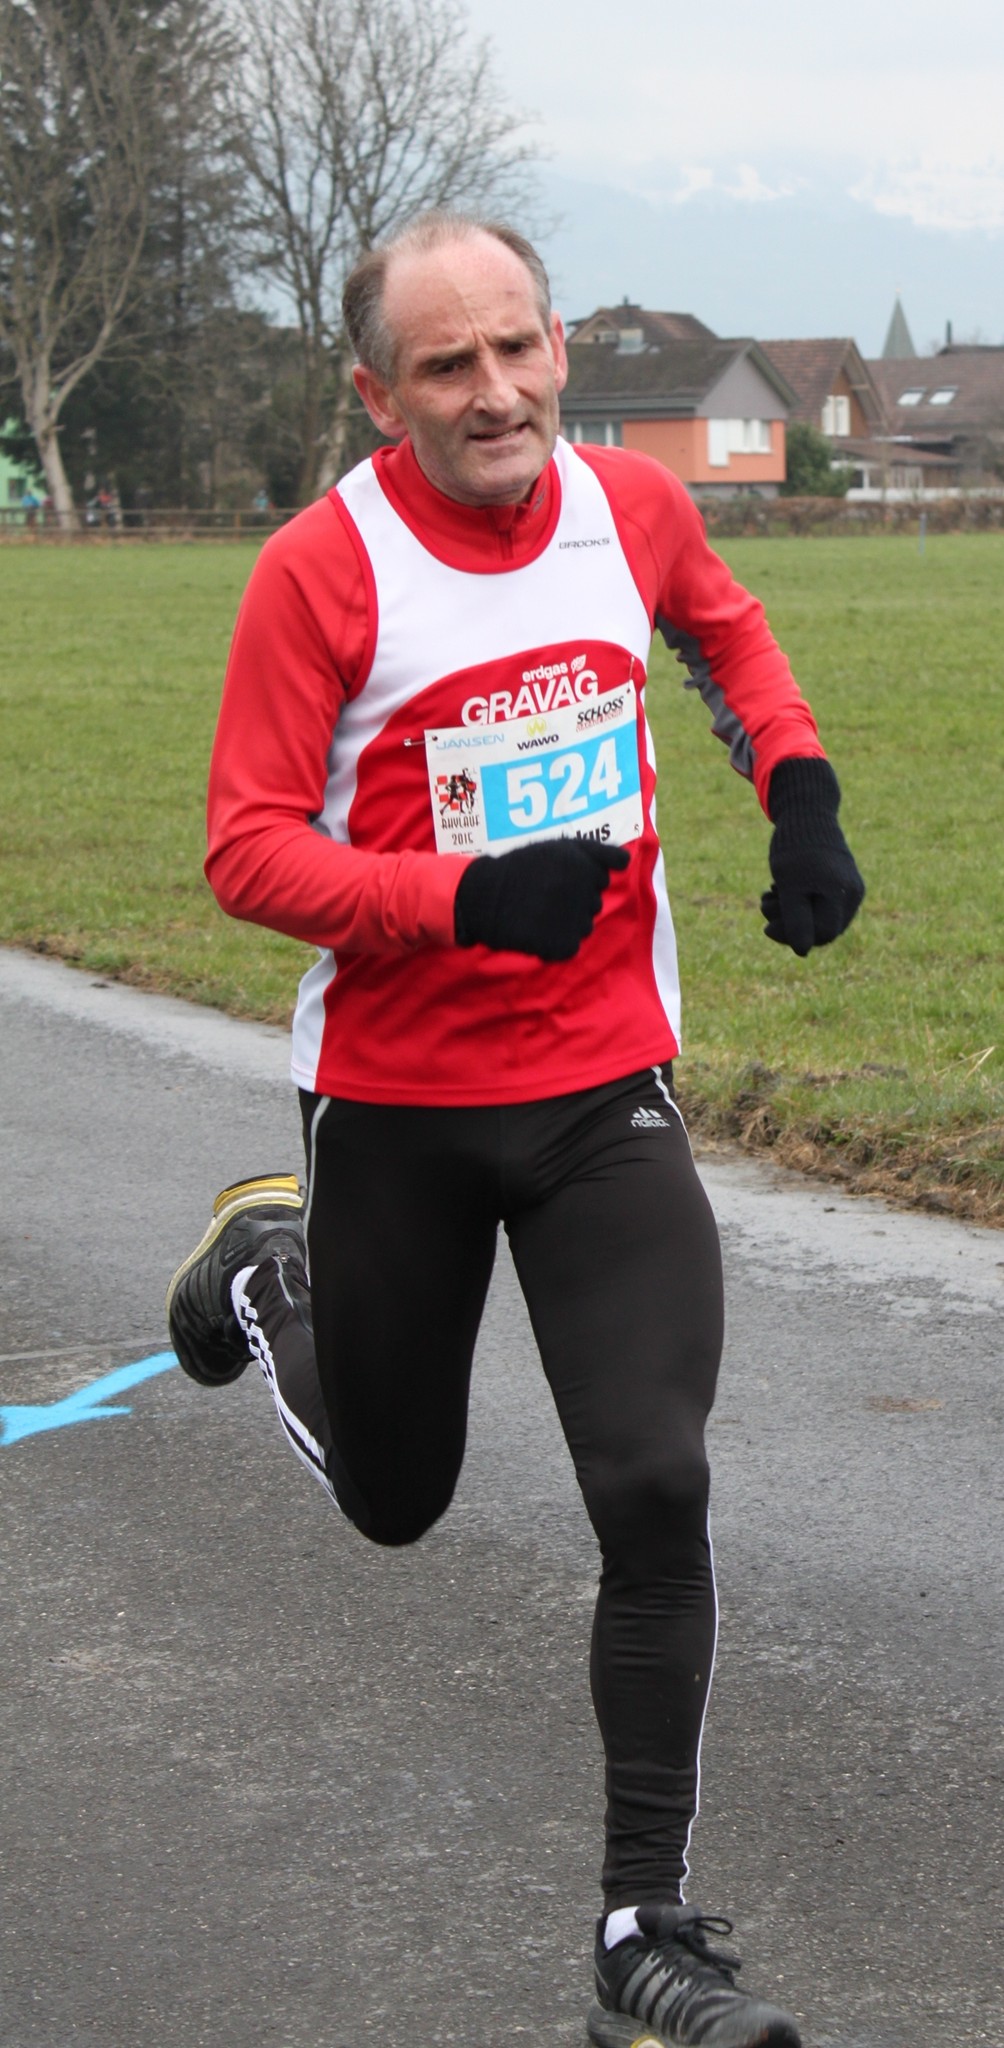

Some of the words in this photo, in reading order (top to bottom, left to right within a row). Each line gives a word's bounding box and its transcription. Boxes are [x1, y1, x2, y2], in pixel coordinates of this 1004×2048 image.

[558, 537, 610, 550] BROOKS
[522, 661, 568, 683] erdgas
[461, 669, 598, 727] GRAVAG
[577, 696, 624, 725] SCHLOSS
[436, 733, 505, 751] JANSEN
[517, 733, 559, 750] WAWO
[506, 737, 622, 828] 524
